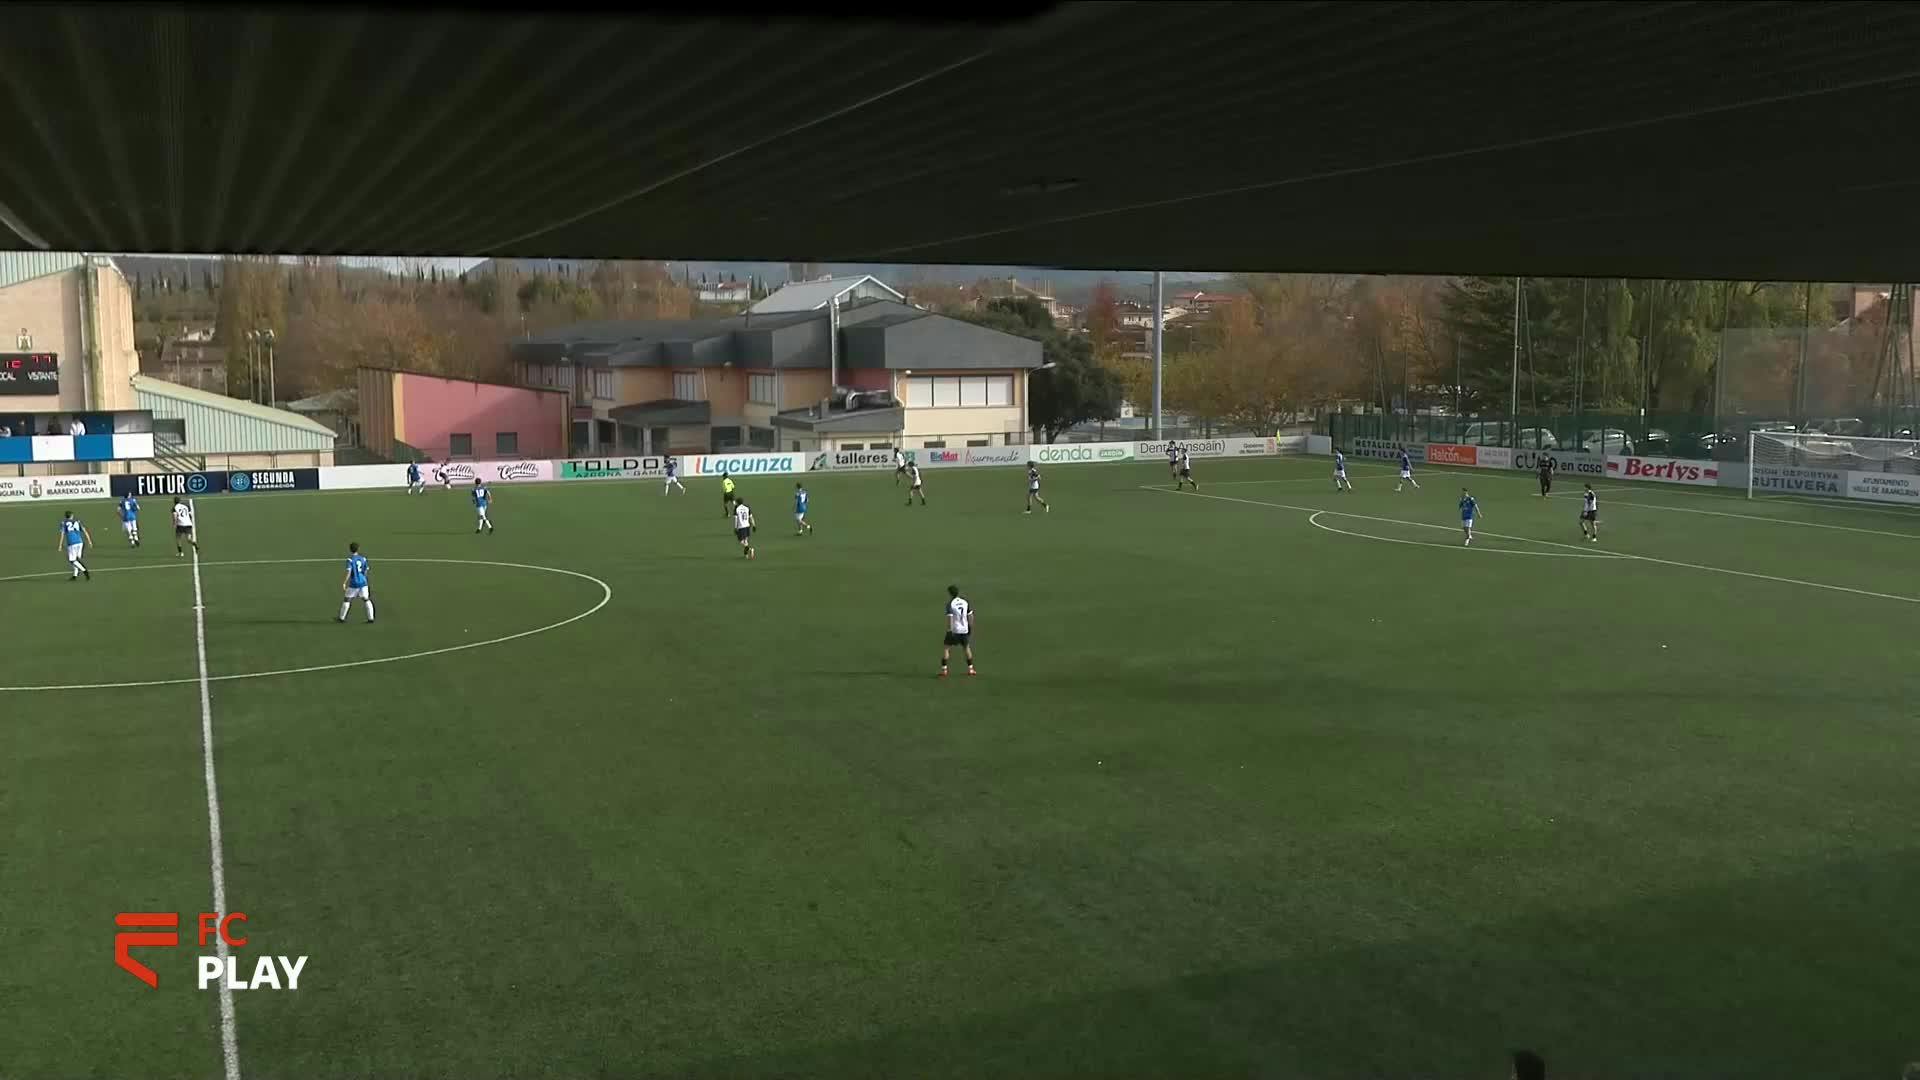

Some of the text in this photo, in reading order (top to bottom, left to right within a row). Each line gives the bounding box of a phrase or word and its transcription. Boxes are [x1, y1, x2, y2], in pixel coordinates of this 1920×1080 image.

[835, 452, 888, 465] talleres
[1039, 443, 1092, 461] denda
[568, 458, 660, 472] TOLDO
[1560, 463, 1575, 471] en
[1577, 463, 1602, 473] casa
[1623, 458, 1700, 481] Berlys
[252, 471, 295, 484] SEGUNDA
[65, 521, 81, 532] 24
